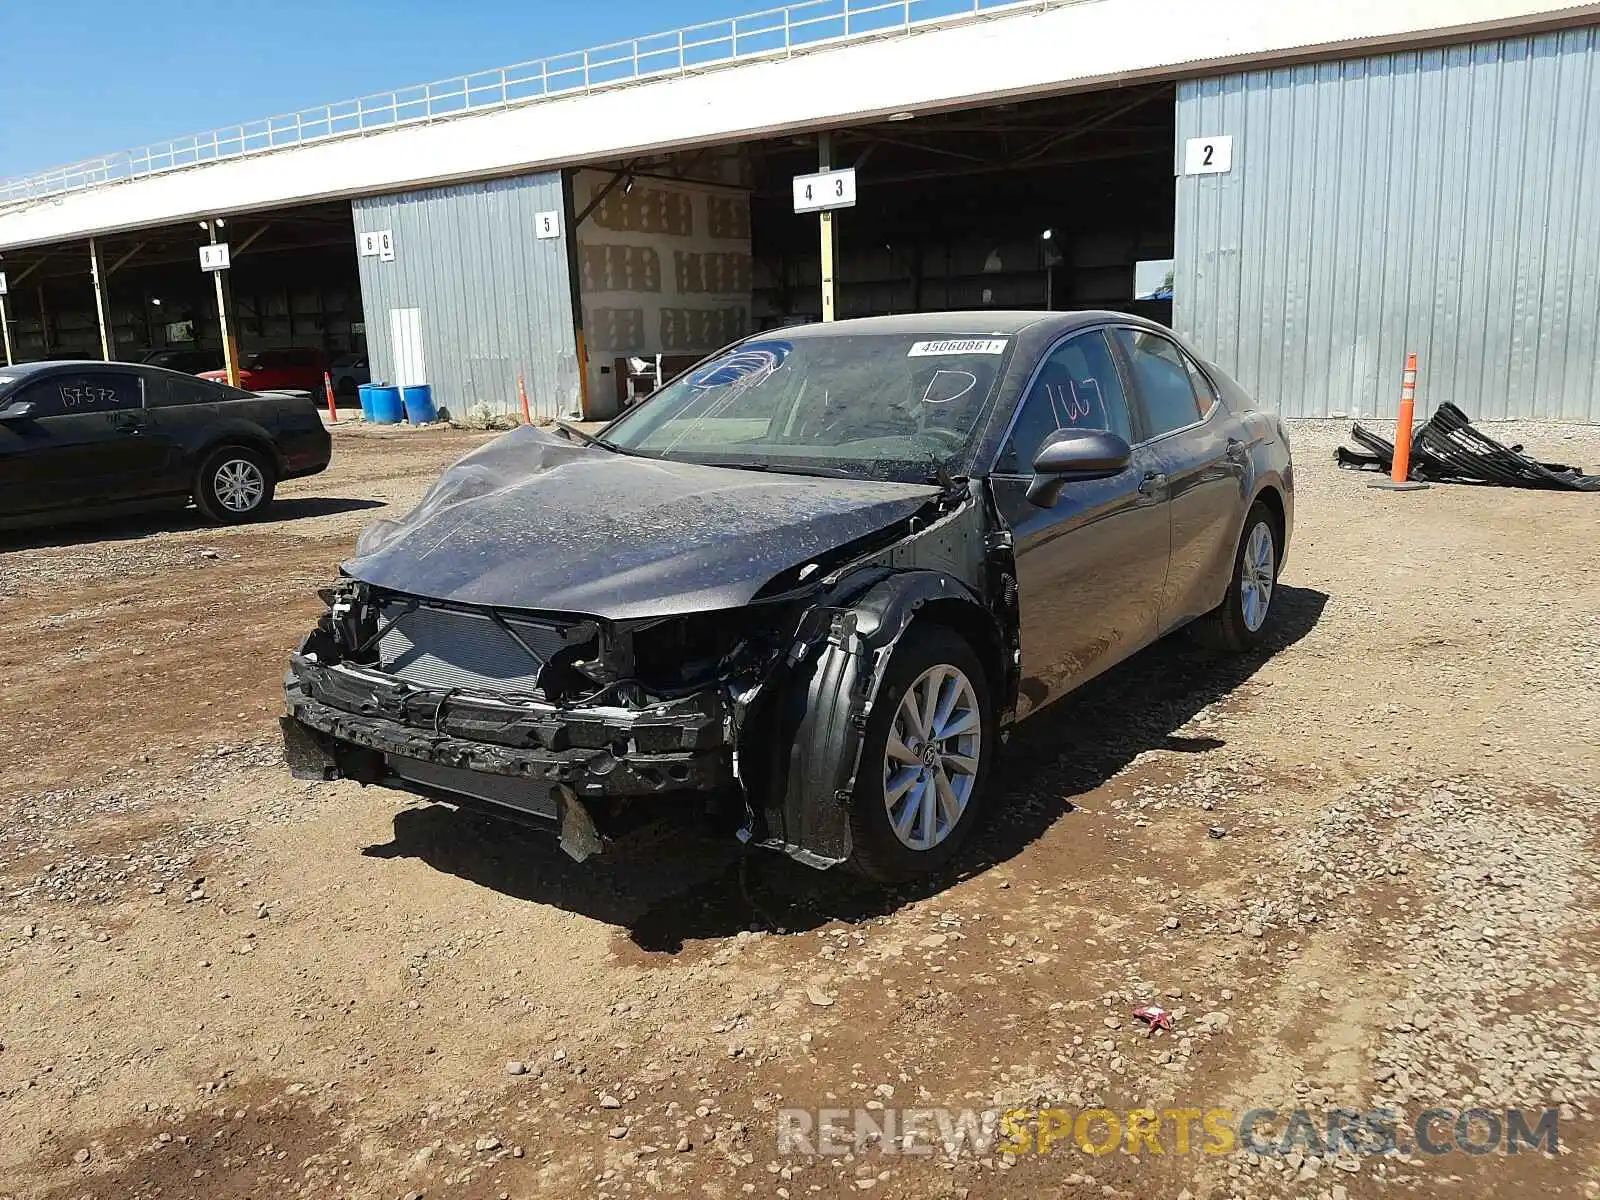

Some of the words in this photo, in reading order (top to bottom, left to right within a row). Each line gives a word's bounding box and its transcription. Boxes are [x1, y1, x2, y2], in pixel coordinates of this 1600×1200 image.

[1203, 145, 1213, 166] 2
[806, 184, 813, 201] 4
[836, 179, 843, 197] 3
[545, 217, 550, 232] 5
